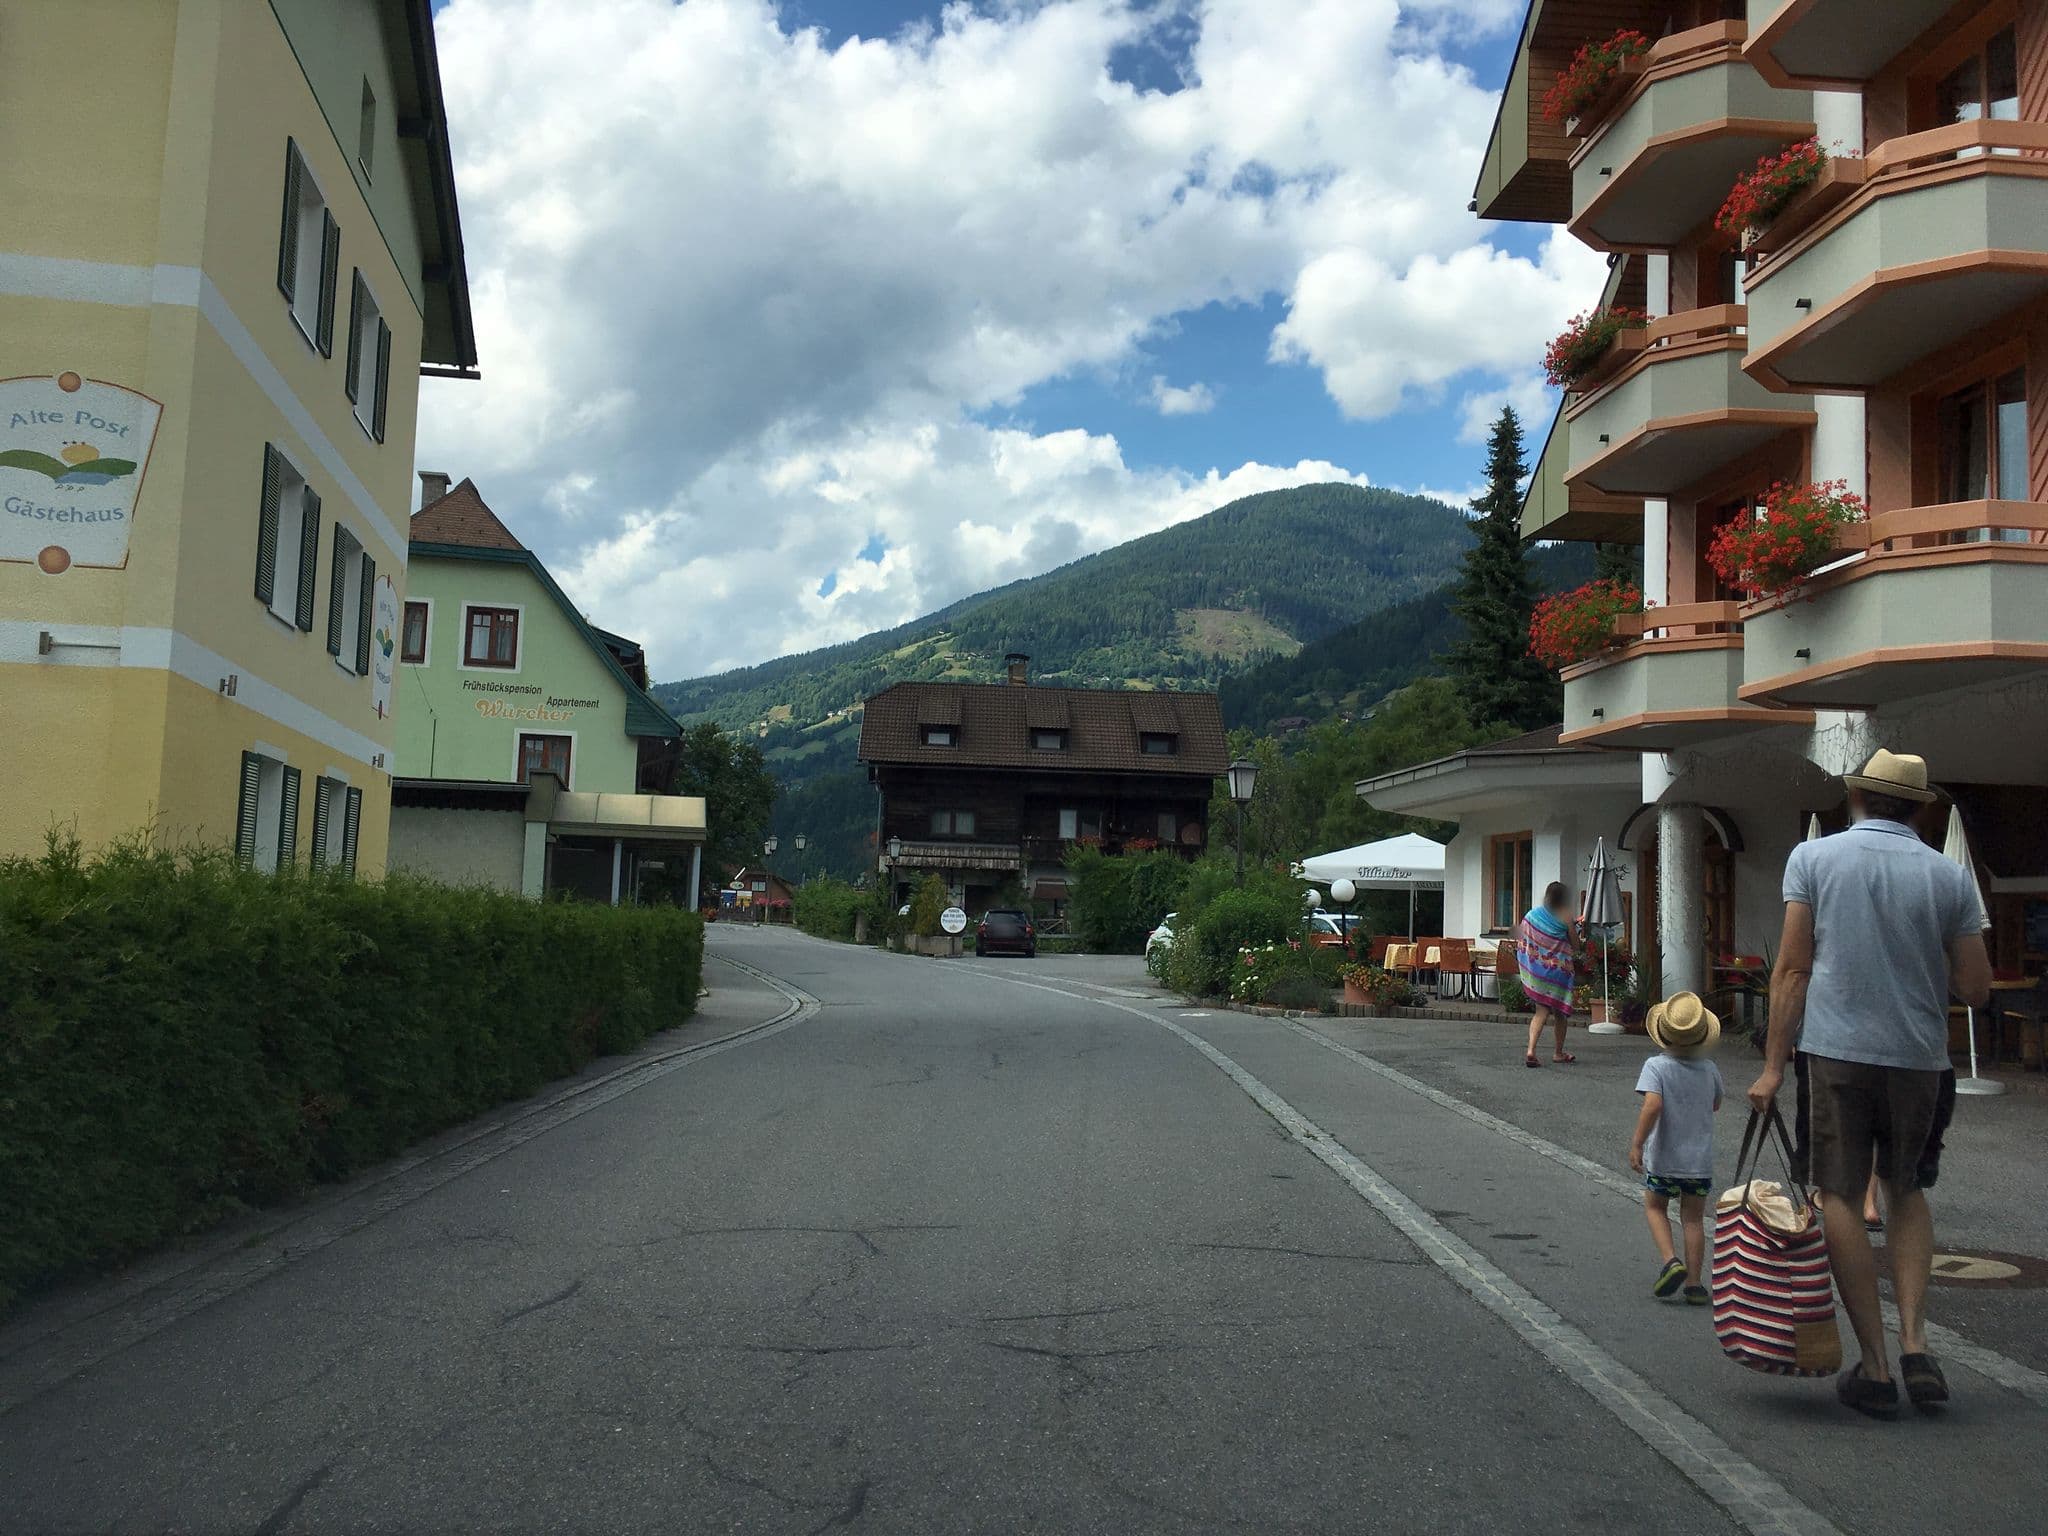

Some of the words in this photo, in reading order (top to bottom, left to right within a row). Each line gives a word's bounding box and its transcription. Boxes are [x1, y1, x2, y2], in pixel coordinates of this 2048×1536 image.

[10, 410, 64, 429] Alte
[75, 410, 130, 437] Post
[4, 496, 125, 523] Gästehaus
[463, 680, 543, 695] Frühstückspension
[546, 696, 600, 709] Appartement
